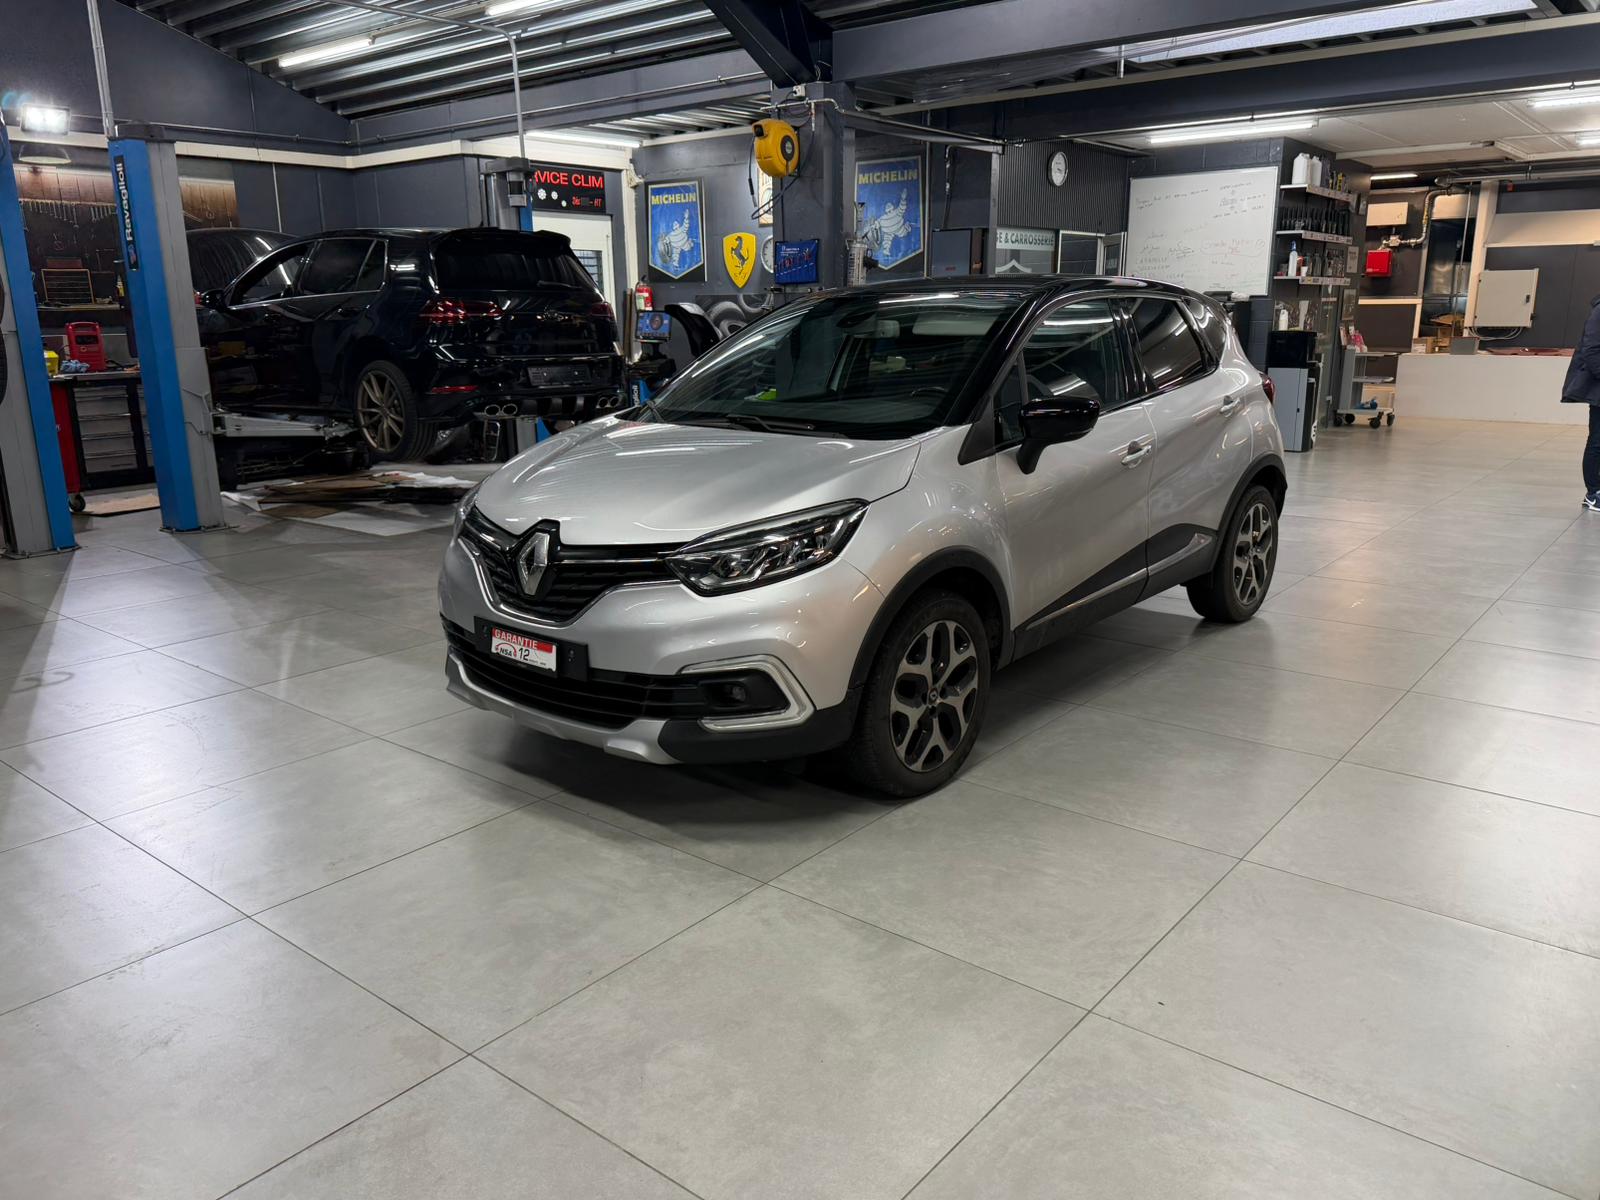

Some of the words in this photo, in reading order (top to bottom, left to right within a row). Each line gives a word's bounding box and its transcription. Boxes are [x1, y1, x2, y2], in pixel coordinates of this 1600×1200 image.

[571, 173, 604, 189] CLIM
[858, 169, 918, 185] MICHELIN
[116, 163, 133, 241] Ravaglioli
[651, 192, 697, 205] MICHELIN
[1004, 232, 1010, 244] &
[1010, 232, 1054, 246] CARROSSERIE
[494, 629, 538, 650] GARANTIE
[500, 647, 513, 657] NSA
[518, 647, 530, 662] 12
